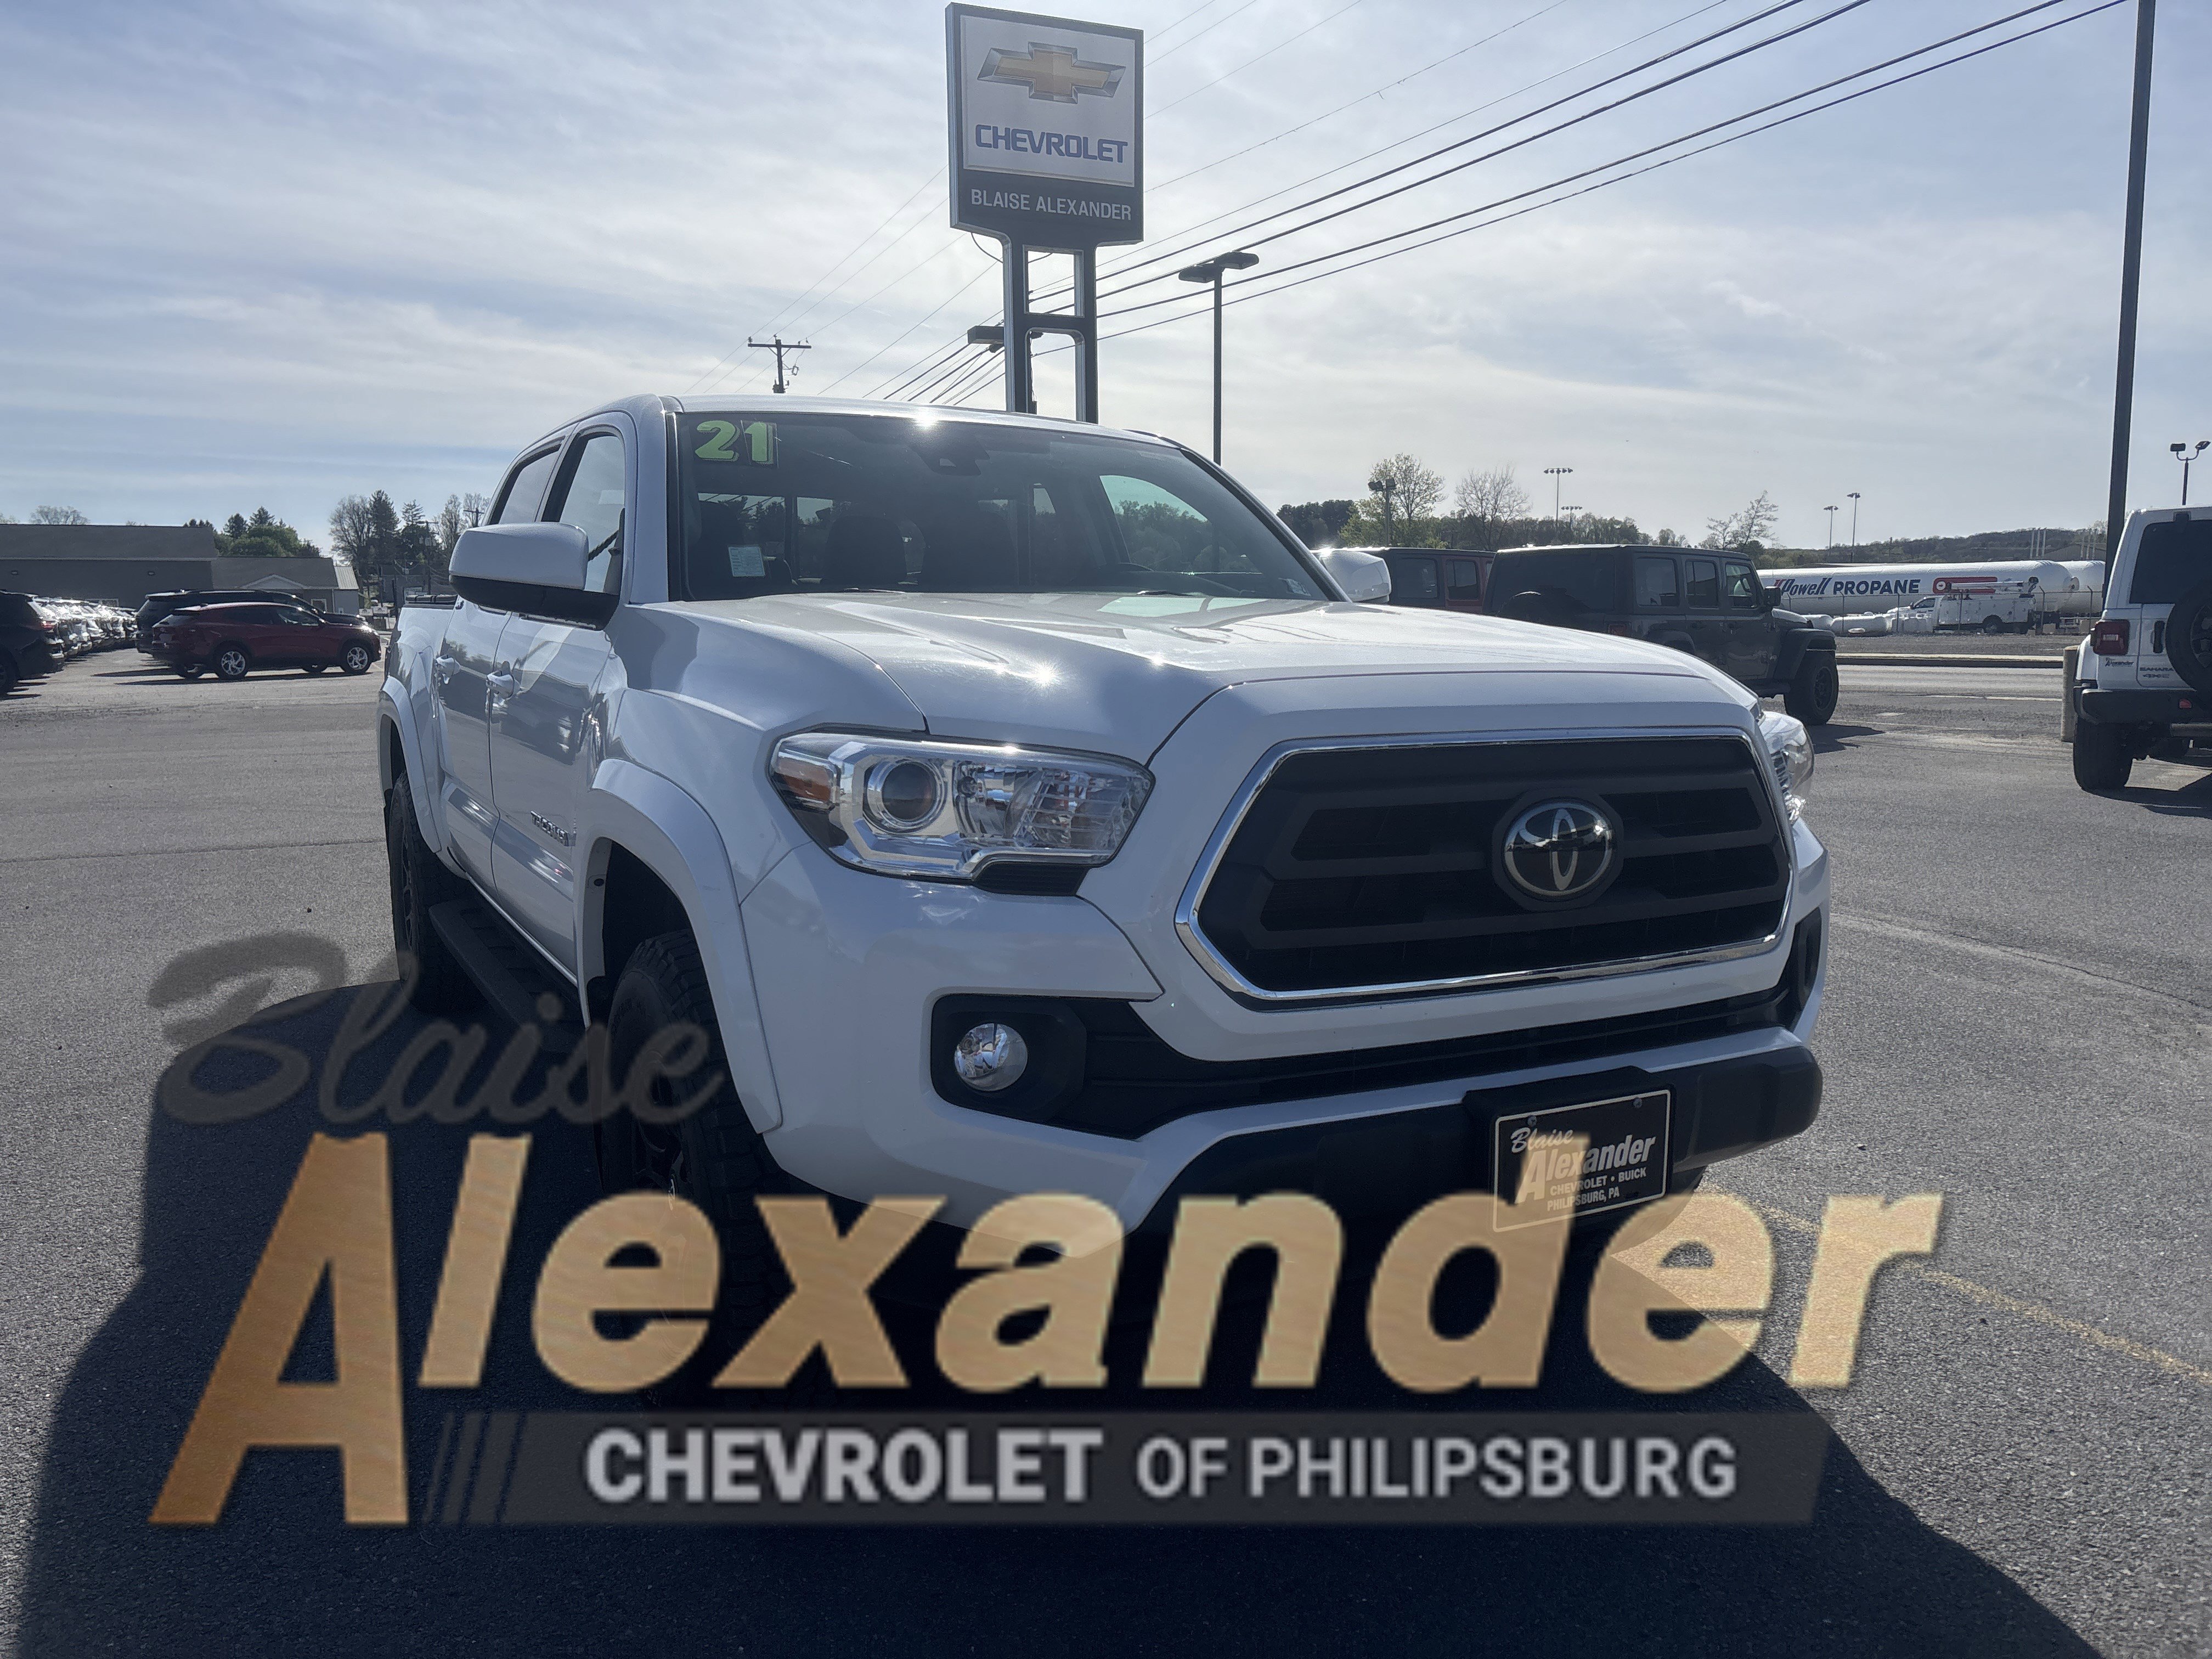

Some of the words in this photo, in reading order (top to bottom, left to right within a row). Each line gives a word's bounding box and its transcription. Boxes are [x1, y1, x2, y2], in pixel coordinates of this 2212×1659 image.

[975, 125, 1128, 163] CHEVROLET
[971, 189, 1030, 210] BLAISE
[1036, 196, 1131, 221] ALEXANDER
[695, 420, 774, 464] 21
[1781, 577, 1833, 596] Powell
[1833, 579, 1921, 595] PROPANE
[1510, 1127, 1574, 1153] Blaise
[1514, 1135, 1656, 1205] Alexander
[1550, 1176, 1607, 1197] CHEVROLET
[1618, 1167, 1647, 1183] BUICK
[1609, 1187, 1620, 1198] PA
